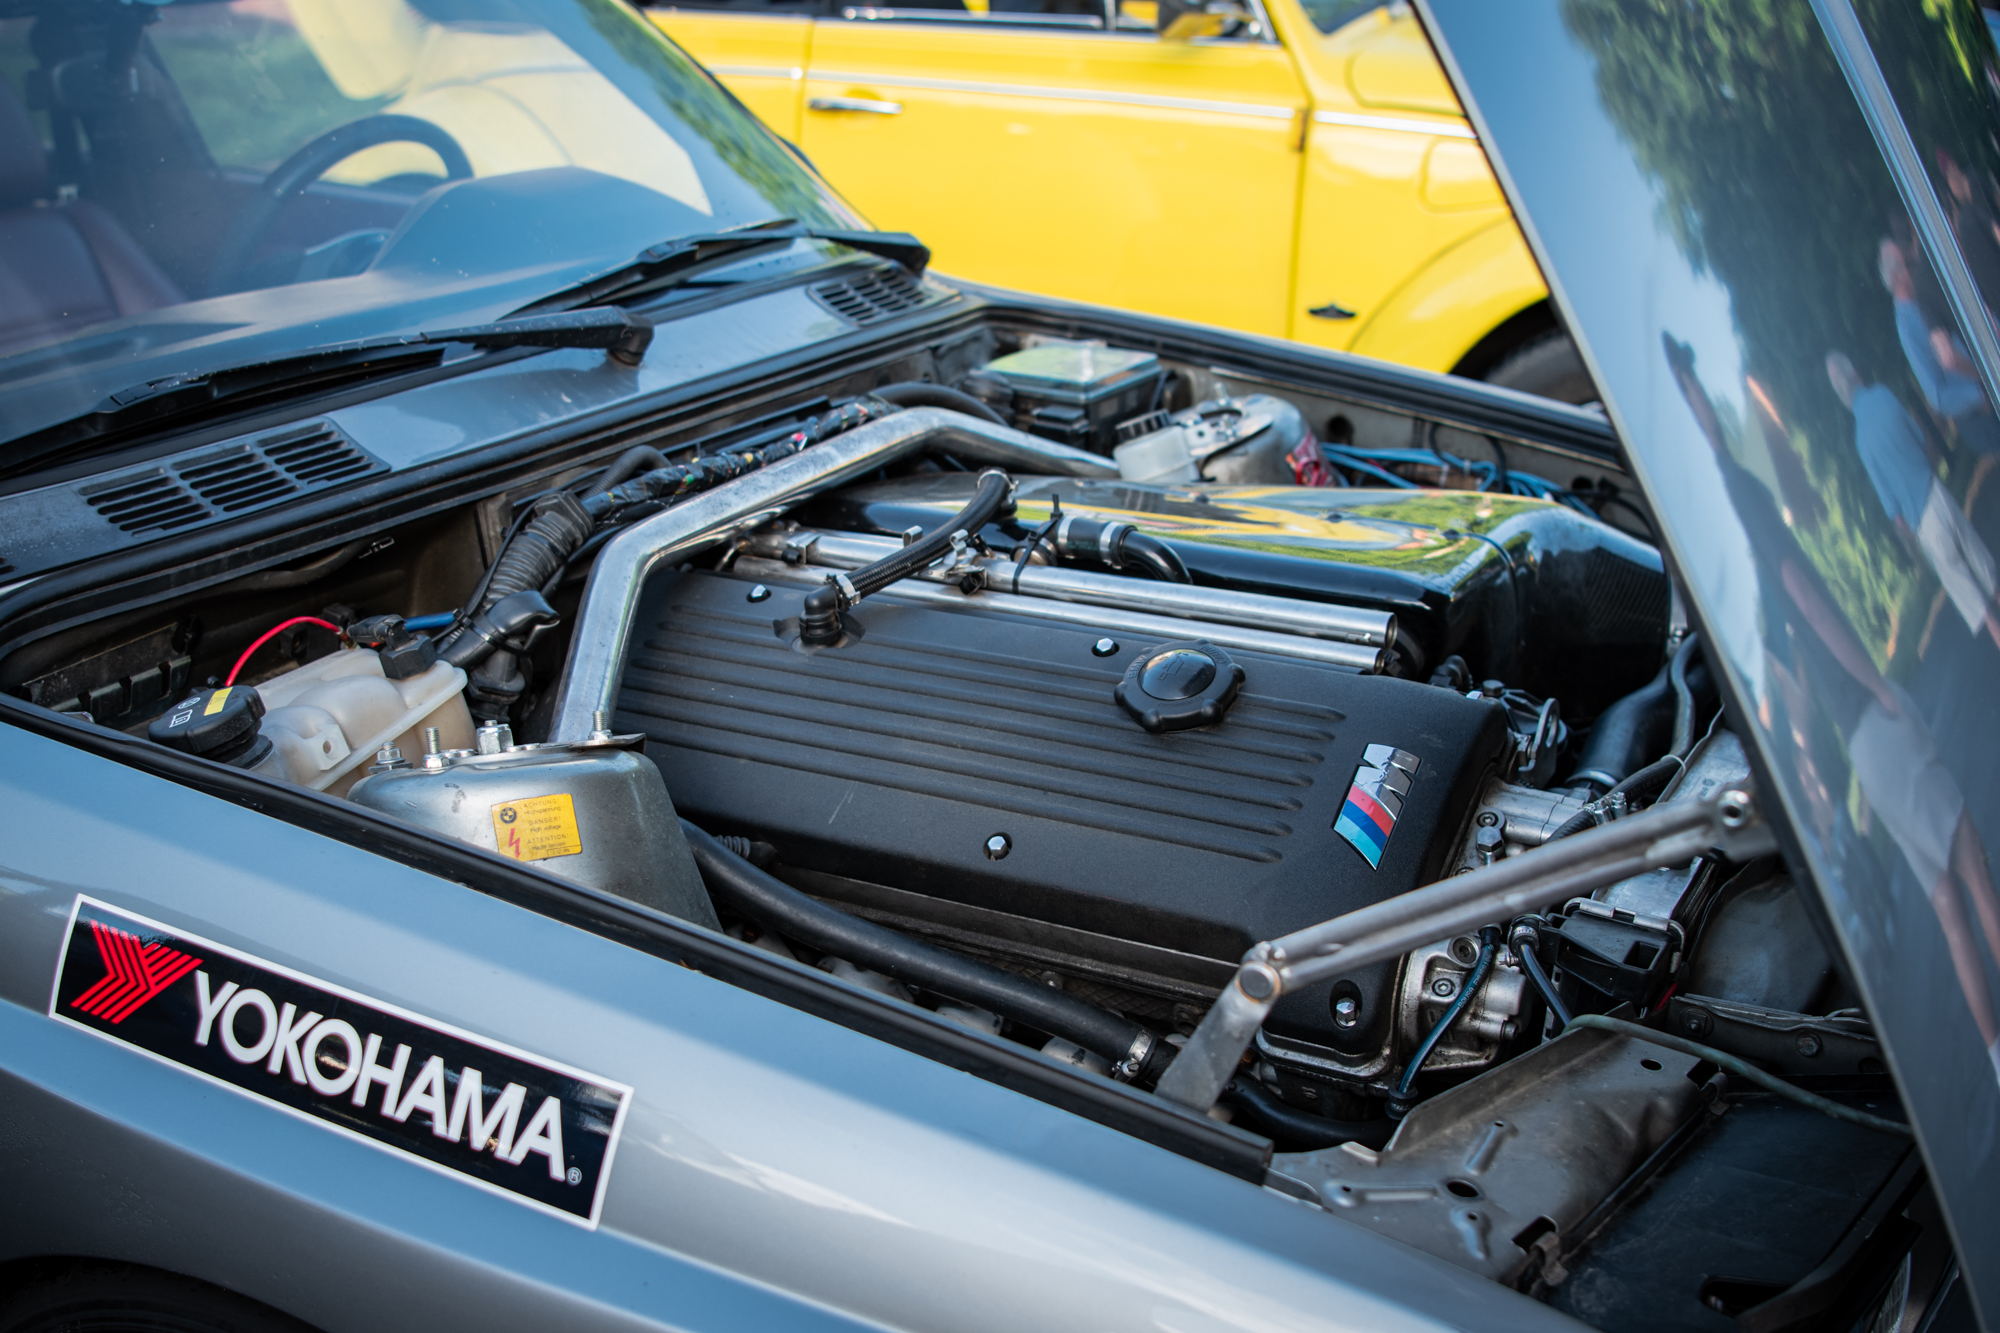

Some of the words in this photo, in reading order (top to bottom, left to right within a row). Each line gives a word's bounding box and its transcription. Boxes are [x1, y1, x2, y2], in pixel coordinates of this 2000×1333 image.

[523, 799, 560, 808] ACHTUNG!
[529, 816, 560, 826] DANGER!
[527, 834, 568, 844] ATTENTION!
[195, 969, 566, 1182] YOKOHAMA
